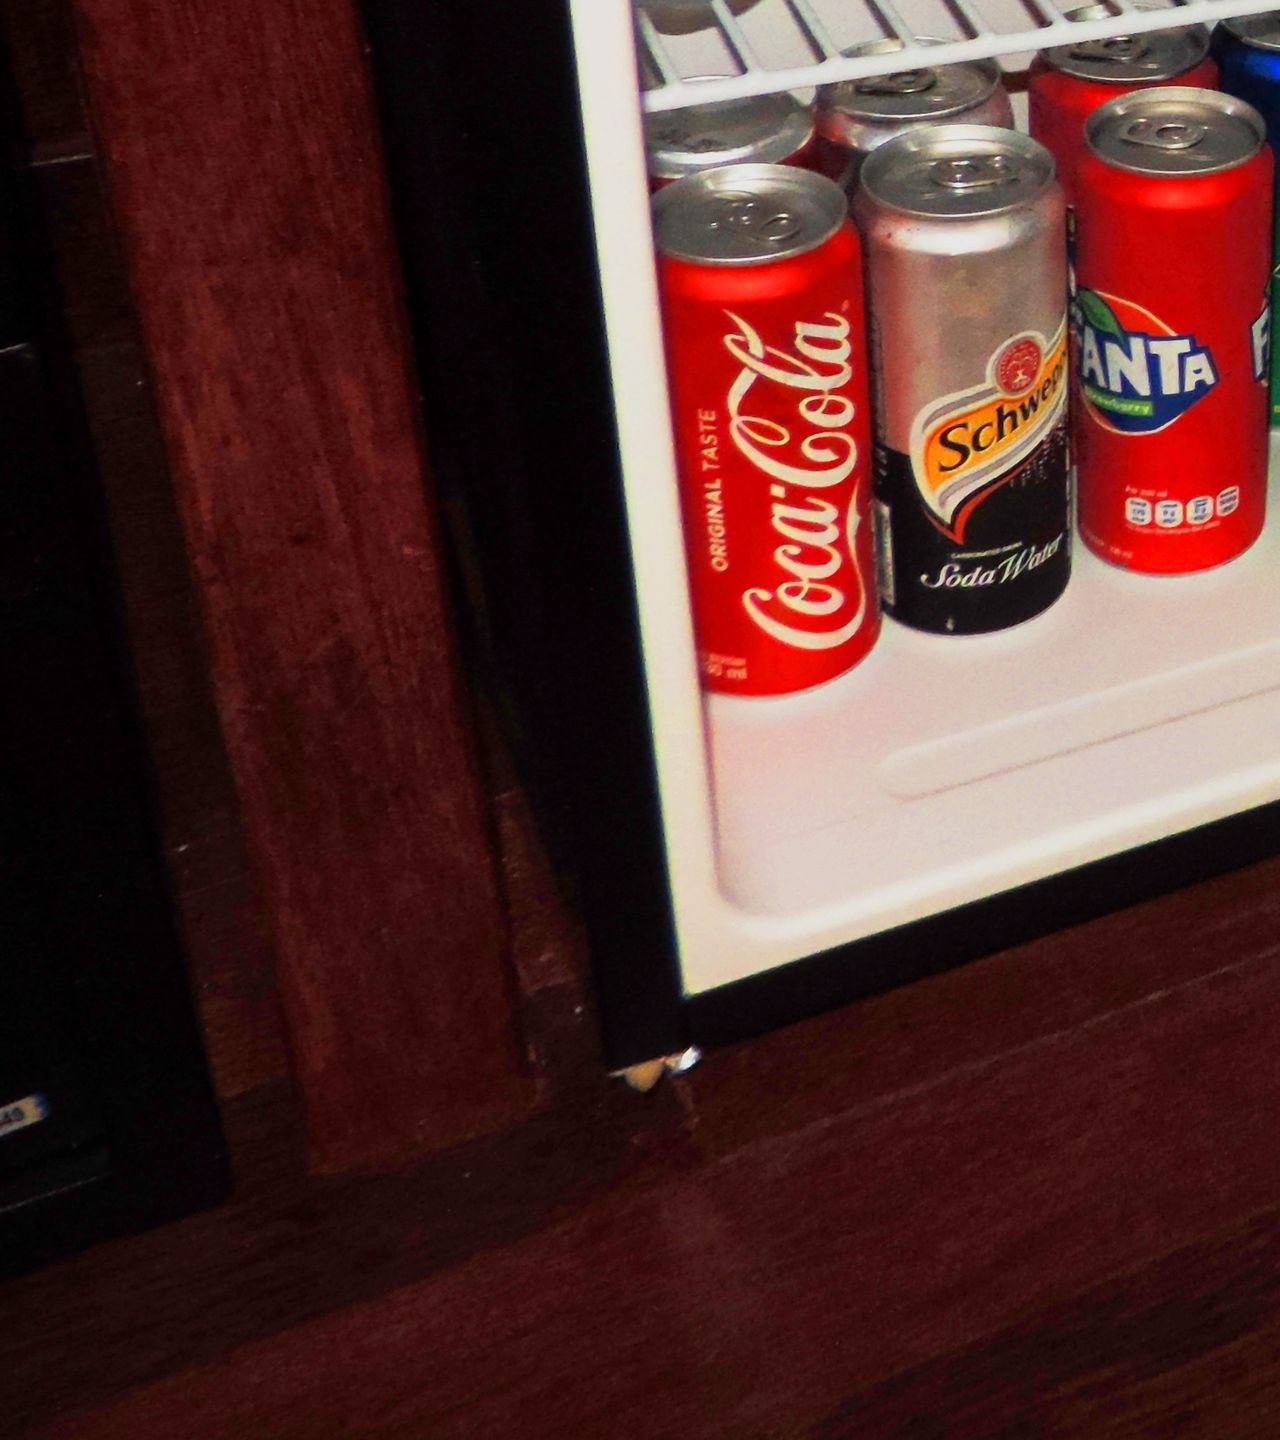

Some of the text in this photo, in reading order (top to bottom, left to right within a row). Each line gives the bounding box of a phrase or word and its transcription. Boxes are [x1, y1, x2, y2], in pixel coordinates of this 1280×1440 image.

[1080, 323, 1217, 397] ANTA
[698, 408, 729, 572] ORIGINAL TASTE
[724, 307, 866, 650] Coca-Cola
[920, 562, 998, 589] Soda
[997, 531, 1065, 585] Water
